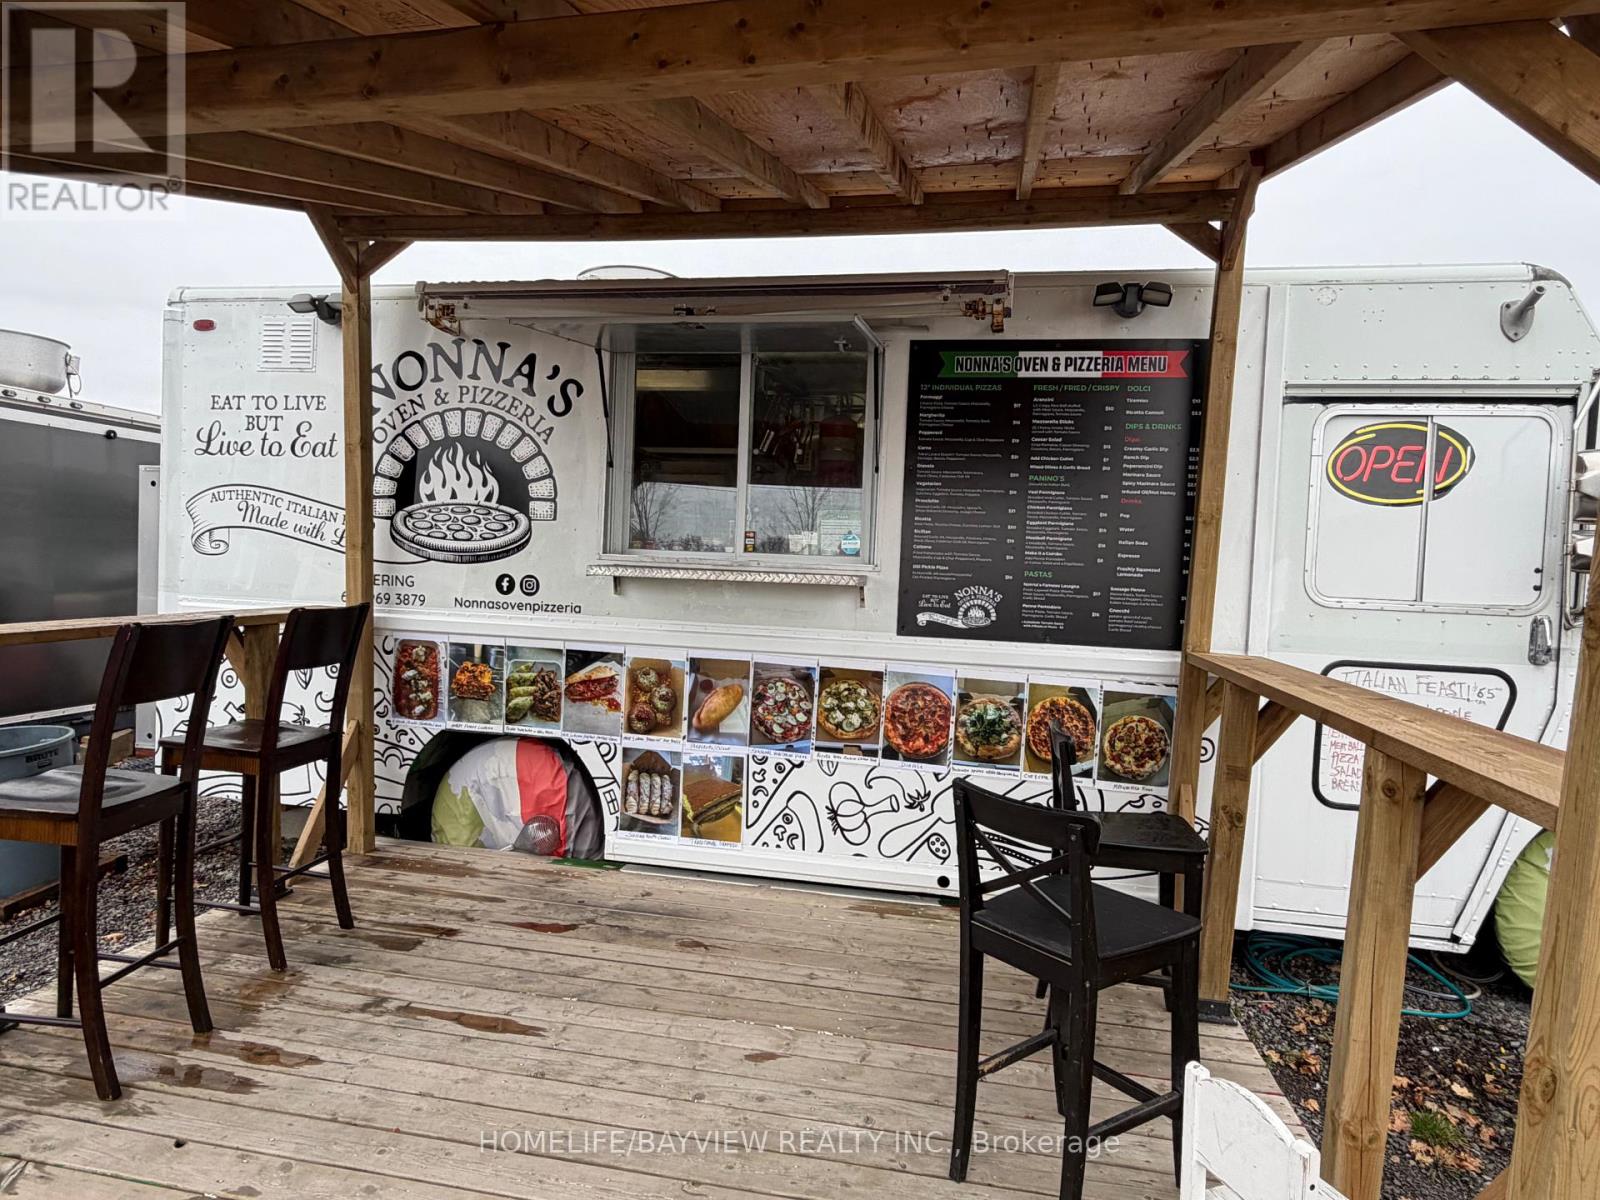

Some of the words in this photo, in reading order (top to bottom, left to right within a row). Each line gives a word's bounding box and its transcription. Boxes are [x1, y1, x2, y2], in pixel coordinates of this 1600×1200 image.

[955, 356, 1012, 373] NONNA'S
[1014, 356, 1048, 373] OVEN
[1052, 357, 1061, 371] &
[1064, 356, 1124, 372] PIZZERIA
[1127, 357, 1168, 373] MENU
[210, 395, 245, 410] EAT
[251, 395, 277, 410] TO
[283, 395, 327, 411] LIVE
[245, 415, 283, 432] BUT
[373, 394, 426, 444] OVEN
[434, 388, 450, 407] &
[458, 385, 557, 444] PIZZERIA
[194, 420, 254, 457] Live
[261, 432, 286, 457] to
[291, 421, 338, 458] Eat
[1336, 445, 1453, 484] OPEN
[210, 489, 284, 509] AUTHENTIC
[286, 501, 339, 523] ITALIAN
[237, 500, 289, 529] Made
[293, 521, 325, 541] with
[373, 574, 415, 587] ERING
[395, 593, 426, 606] 3879
[954, 585, 1003, 603] NONNA'S
[454, 597, 582, 614] Nonnasovenpizzeria
[1341, 669, 1408, 694] ITALIAN
